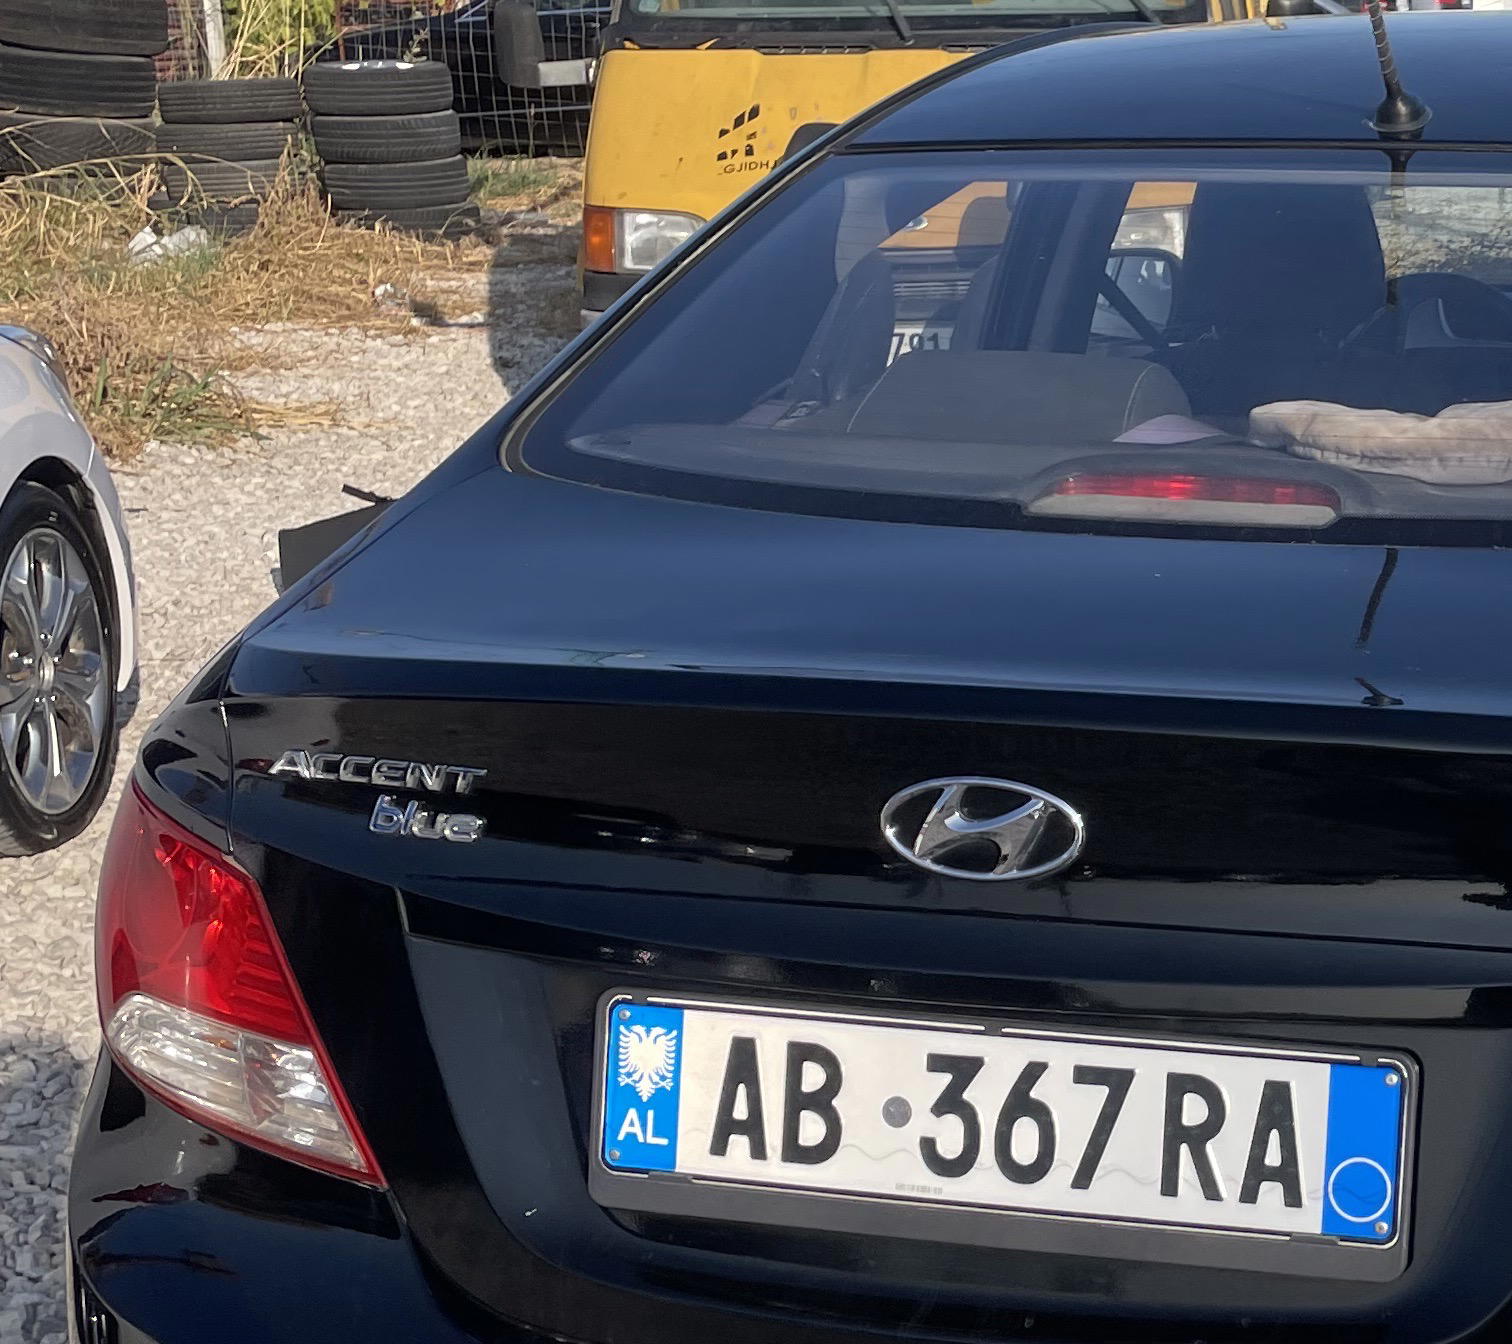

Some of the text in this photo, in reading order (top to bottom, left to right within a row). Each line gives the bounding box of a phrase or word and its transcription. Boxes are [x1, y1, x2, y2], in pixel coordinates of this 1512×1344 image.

[267, 749, 488, 794] ACCENT
[368, 794, 486, 843] blue
[617, 1108, 669, 1145] AL
[709, 1035, 1304, 1209] AB 367 RA
